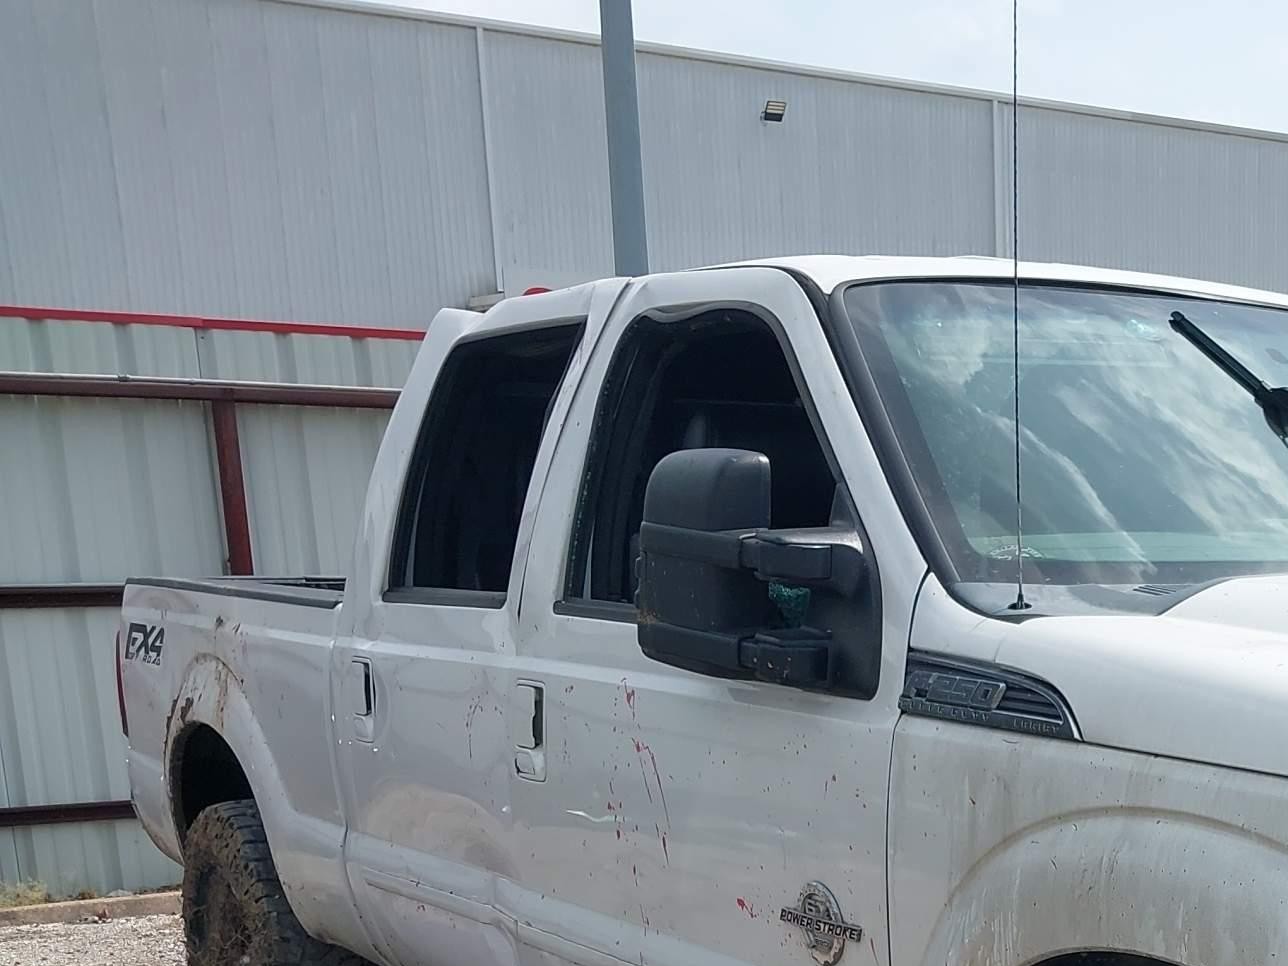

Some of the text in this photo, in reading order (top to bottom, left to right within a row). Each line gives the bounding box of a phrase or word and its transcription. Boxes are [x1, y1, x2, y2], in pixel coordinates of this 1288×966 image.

[125, 622, 165, 660] FX4
[780, 908, 857, 941] POWER STROKE
